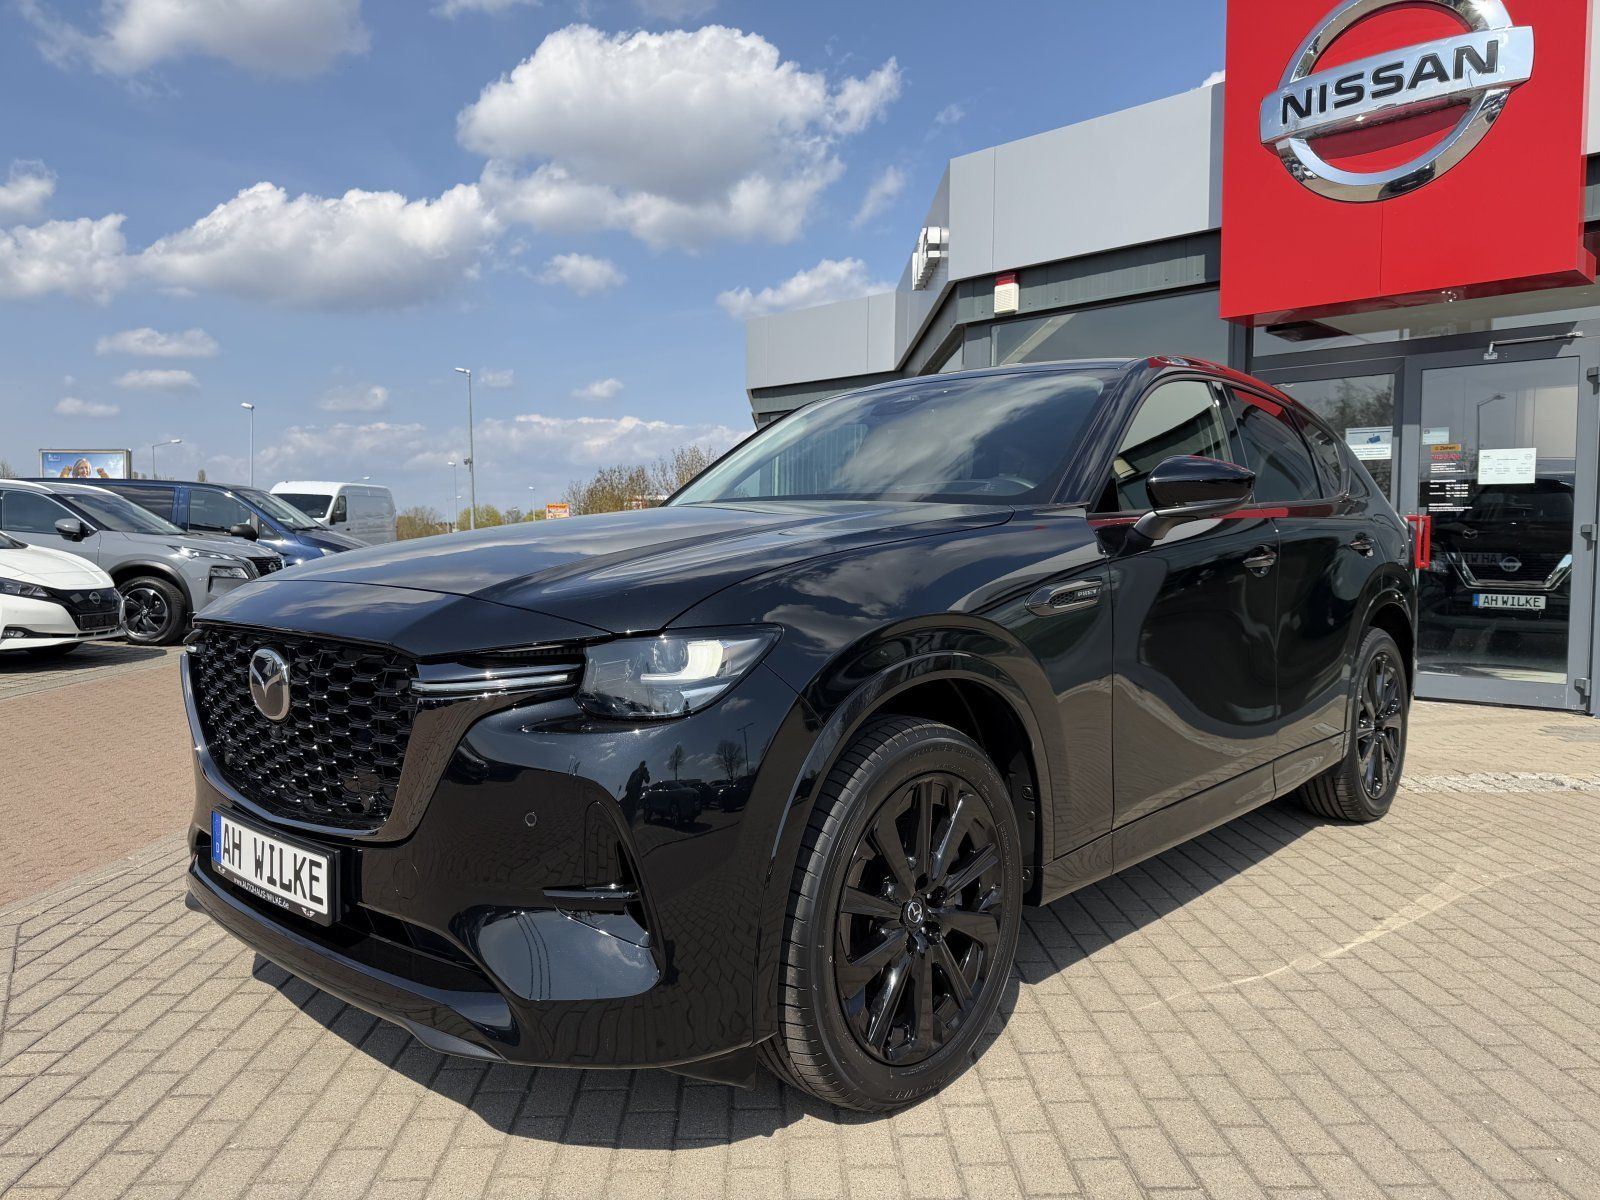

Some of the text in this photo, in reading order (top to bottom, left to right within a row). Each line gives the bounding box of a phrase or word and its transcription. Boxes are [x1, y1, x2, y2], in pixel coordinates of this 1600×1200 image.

[1281, 40, 1499, 125] NISSAN
[1483, 595, 1542, 608] AH WILKE
[223, 823, 324, 906] AH WILKE
